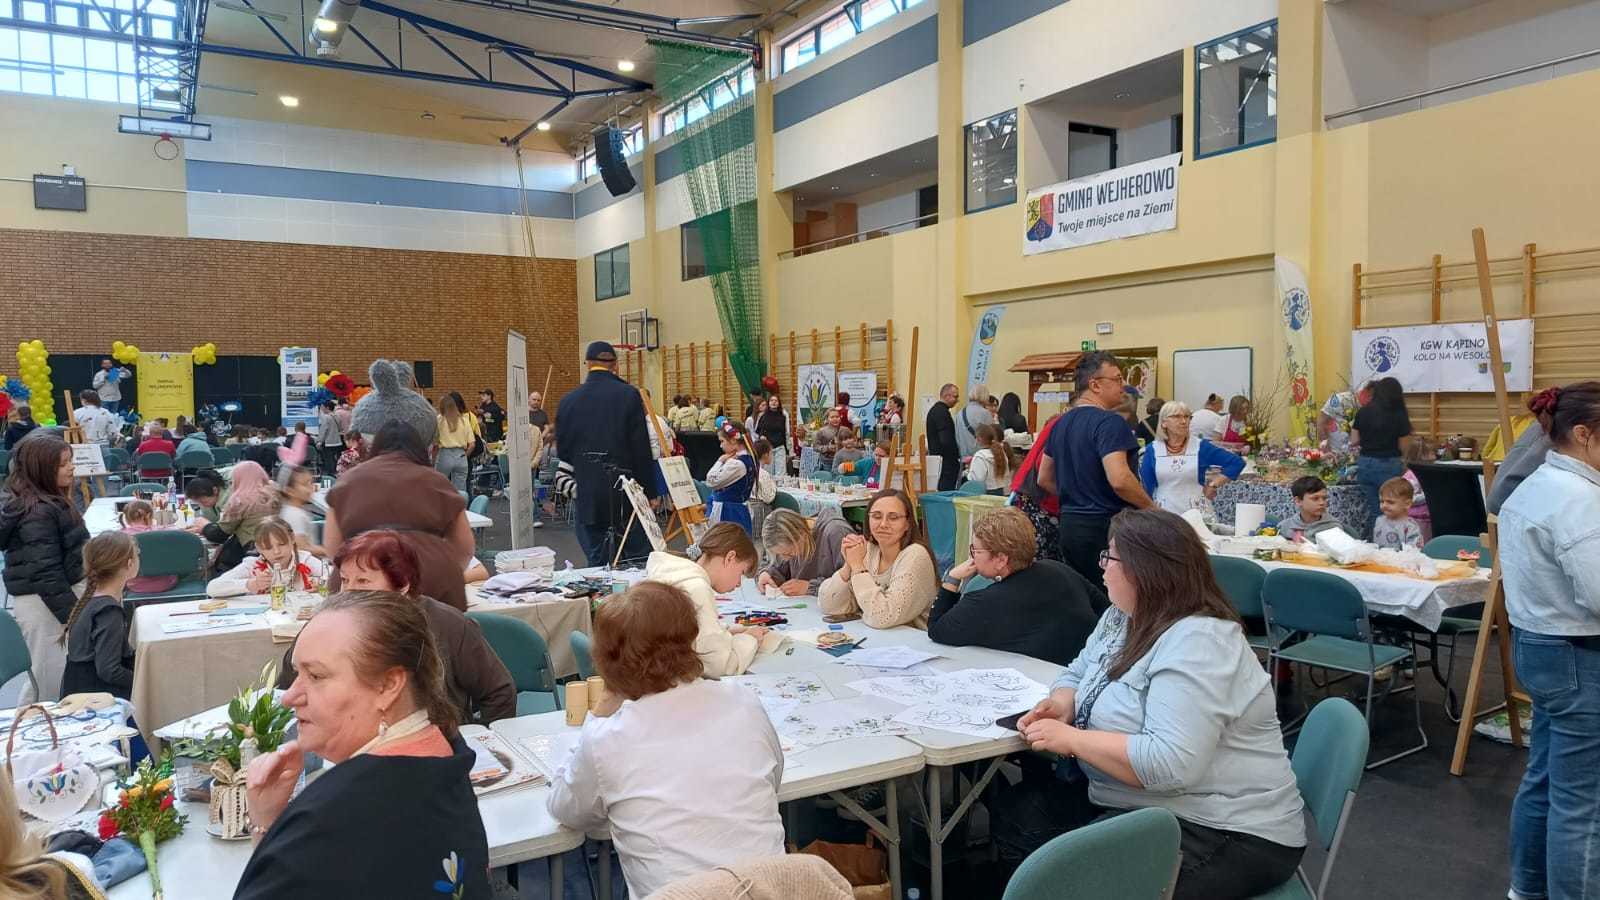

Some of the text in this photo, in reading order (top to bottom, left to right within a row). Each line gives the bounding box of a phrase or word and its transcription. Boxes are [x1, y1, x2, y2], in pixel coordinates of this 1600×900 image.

[1058, 166, 1174, 214] GMINA WEJHEROWO
[1058, 199, 1174, 233] Twoje miejsce na Ziemi
[1421, 340, 1442, 350] KGW
[1438, 352, 1451, 360] NA
